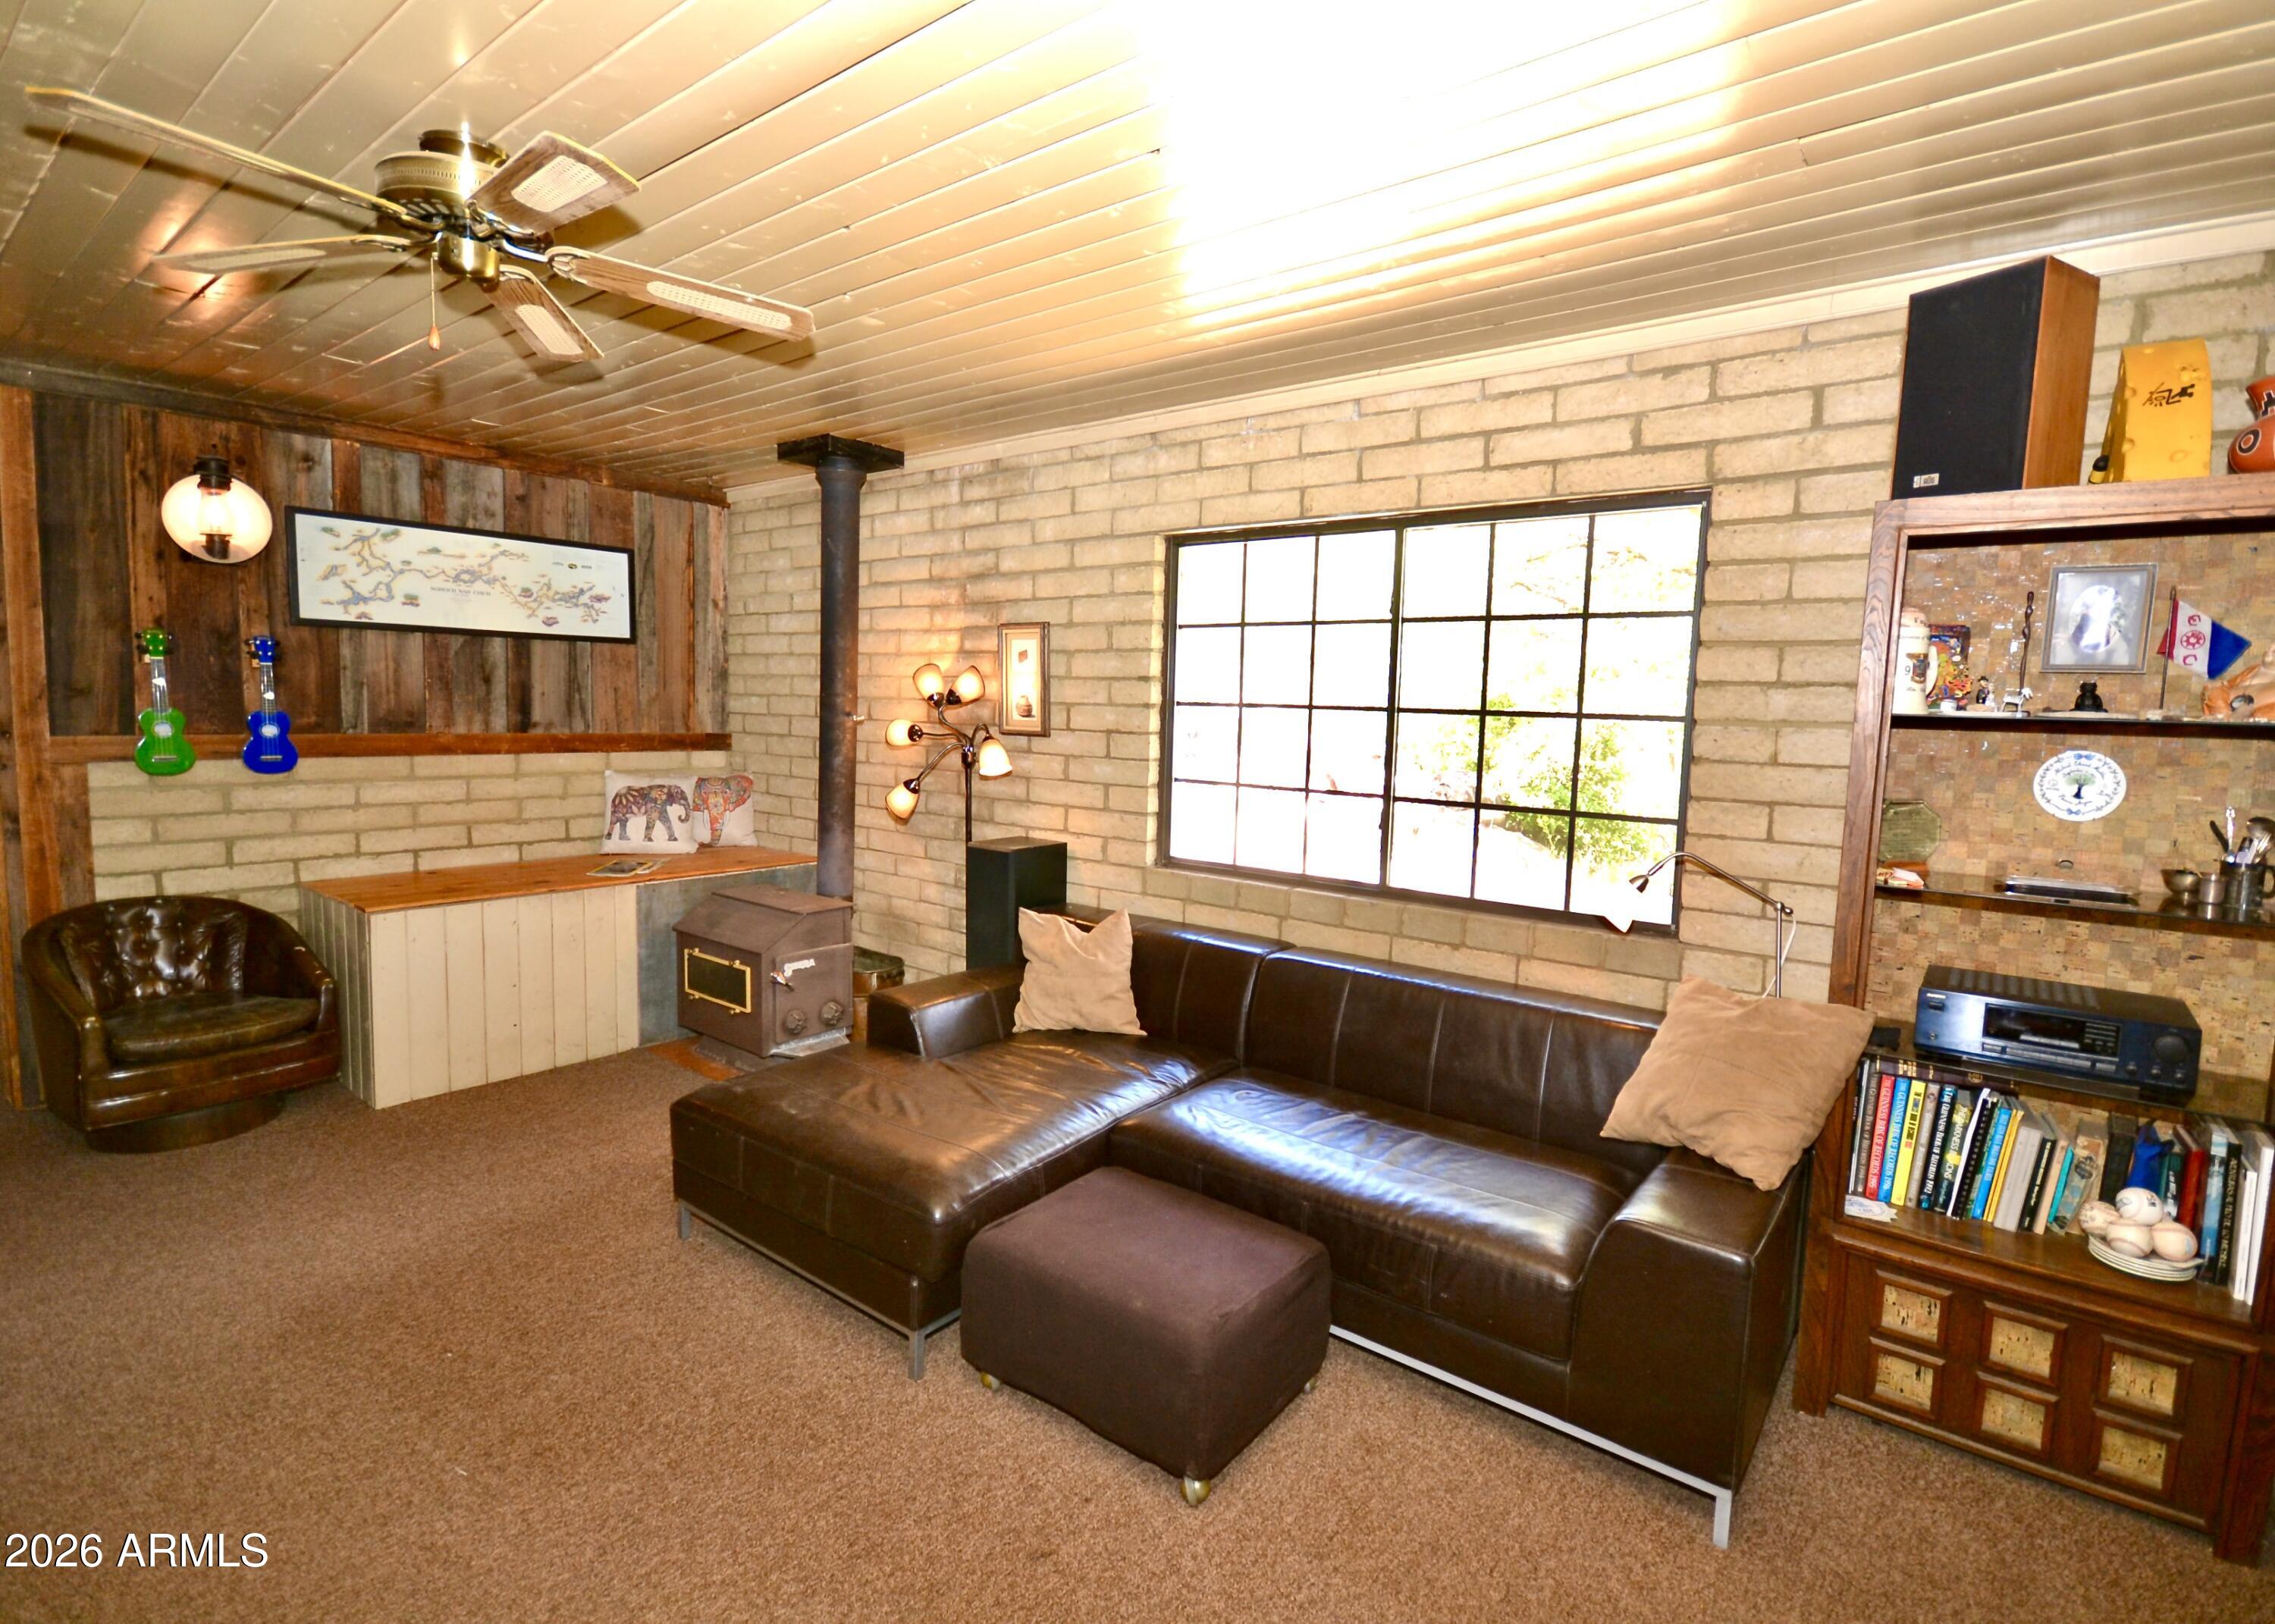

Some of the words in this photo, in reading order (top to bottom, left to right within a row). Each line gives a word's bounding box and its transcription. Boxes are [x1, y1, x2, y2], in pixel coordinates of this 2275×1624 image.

[1878, 1087, 1891, 1119] GUINNESS
[1893, 1091, 1906, 1122] GUINNESS
[1876, 1119, 1886, 1134] BOOK
[1891, 1122, 1901, 1138] BOOK
[1936, 1103, 1950, 1132] GUINNESS
[1875, 1135, 1884, 1143] OF
[1889, 1138, 1899, 1147] OF
[1933, 1131, 1944, 1147] BOOK
[1871, 1145, 1883, 1174] RECORDS
[1884, 1147, 1897, 1176] RECORDS
[1926, 1153, 1940, 1180] RECORDS
